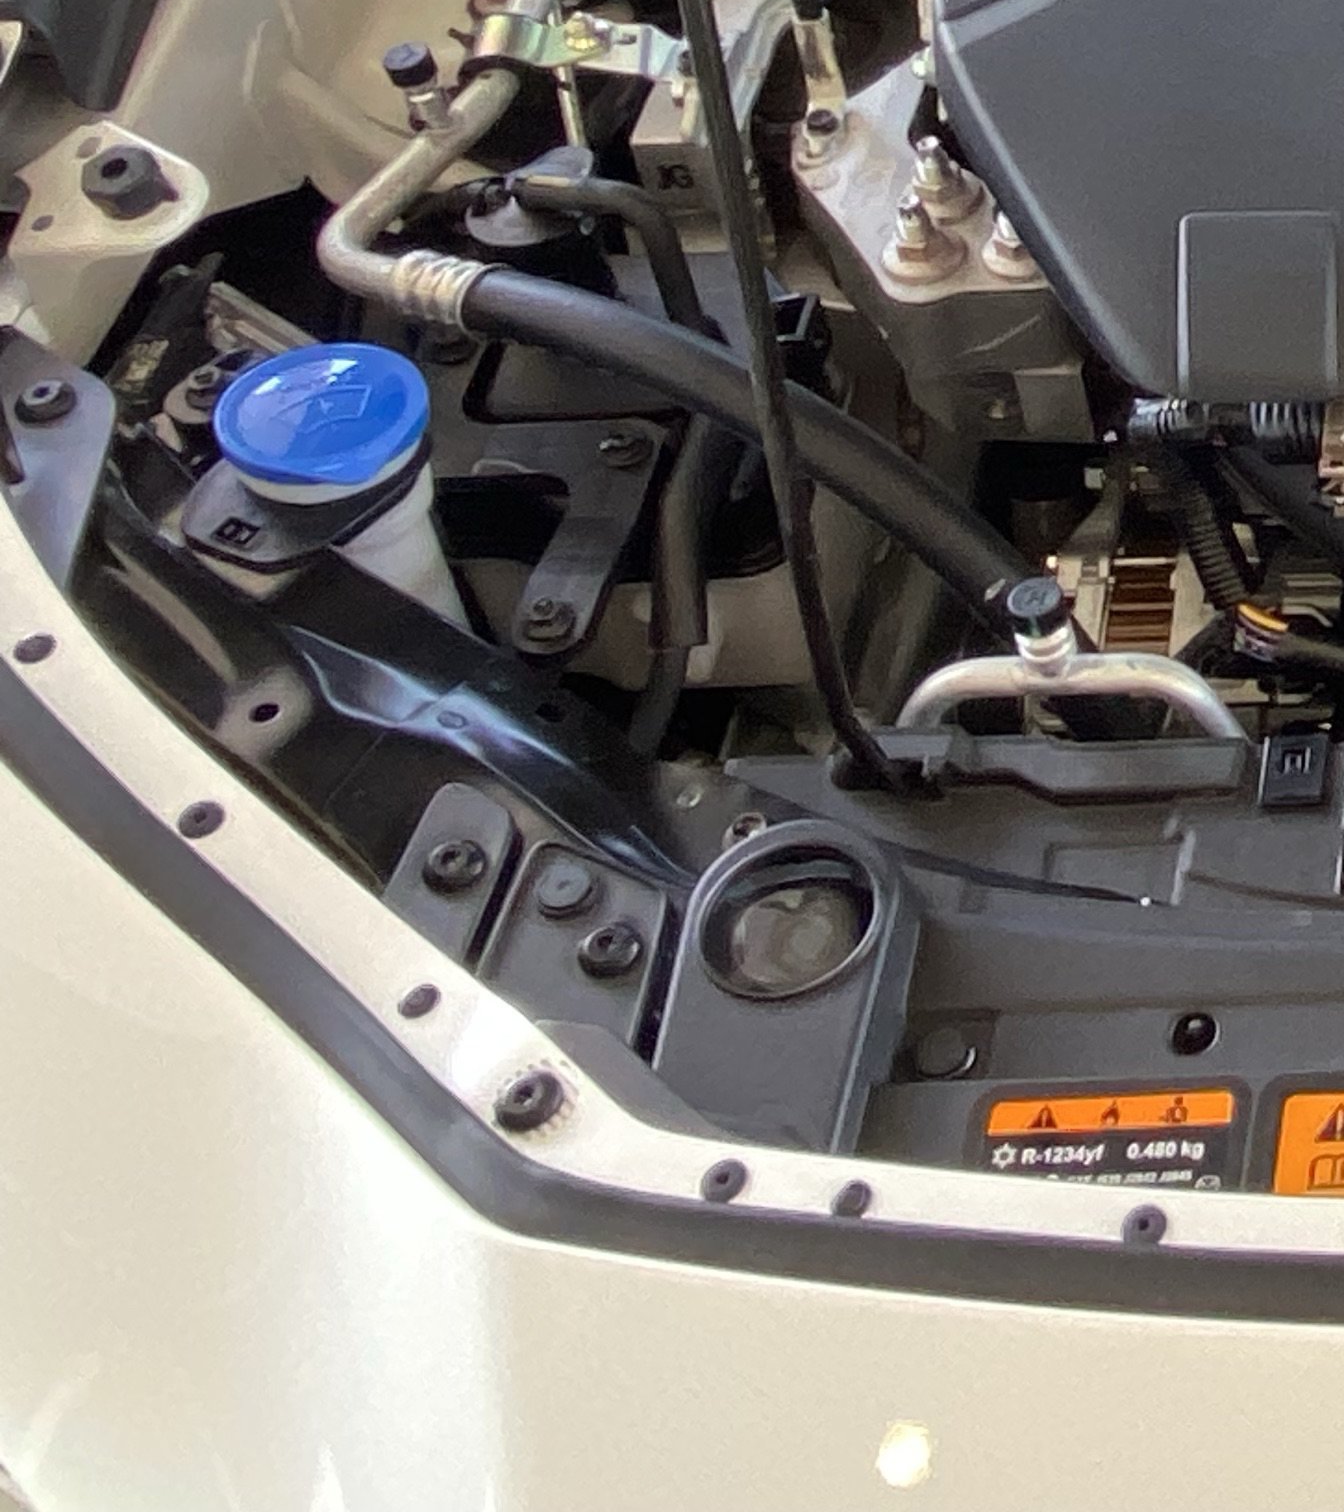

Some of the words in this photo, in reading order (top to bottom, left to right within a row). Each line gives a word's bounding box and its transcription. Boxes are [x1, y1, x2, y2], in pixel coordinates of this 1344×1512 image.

[1020, 1141, 1106, 1166] R-1234yf
[1126, 1140, 1179, 1161] 0.480
[1180, 1138, 1206, 1162] kg
